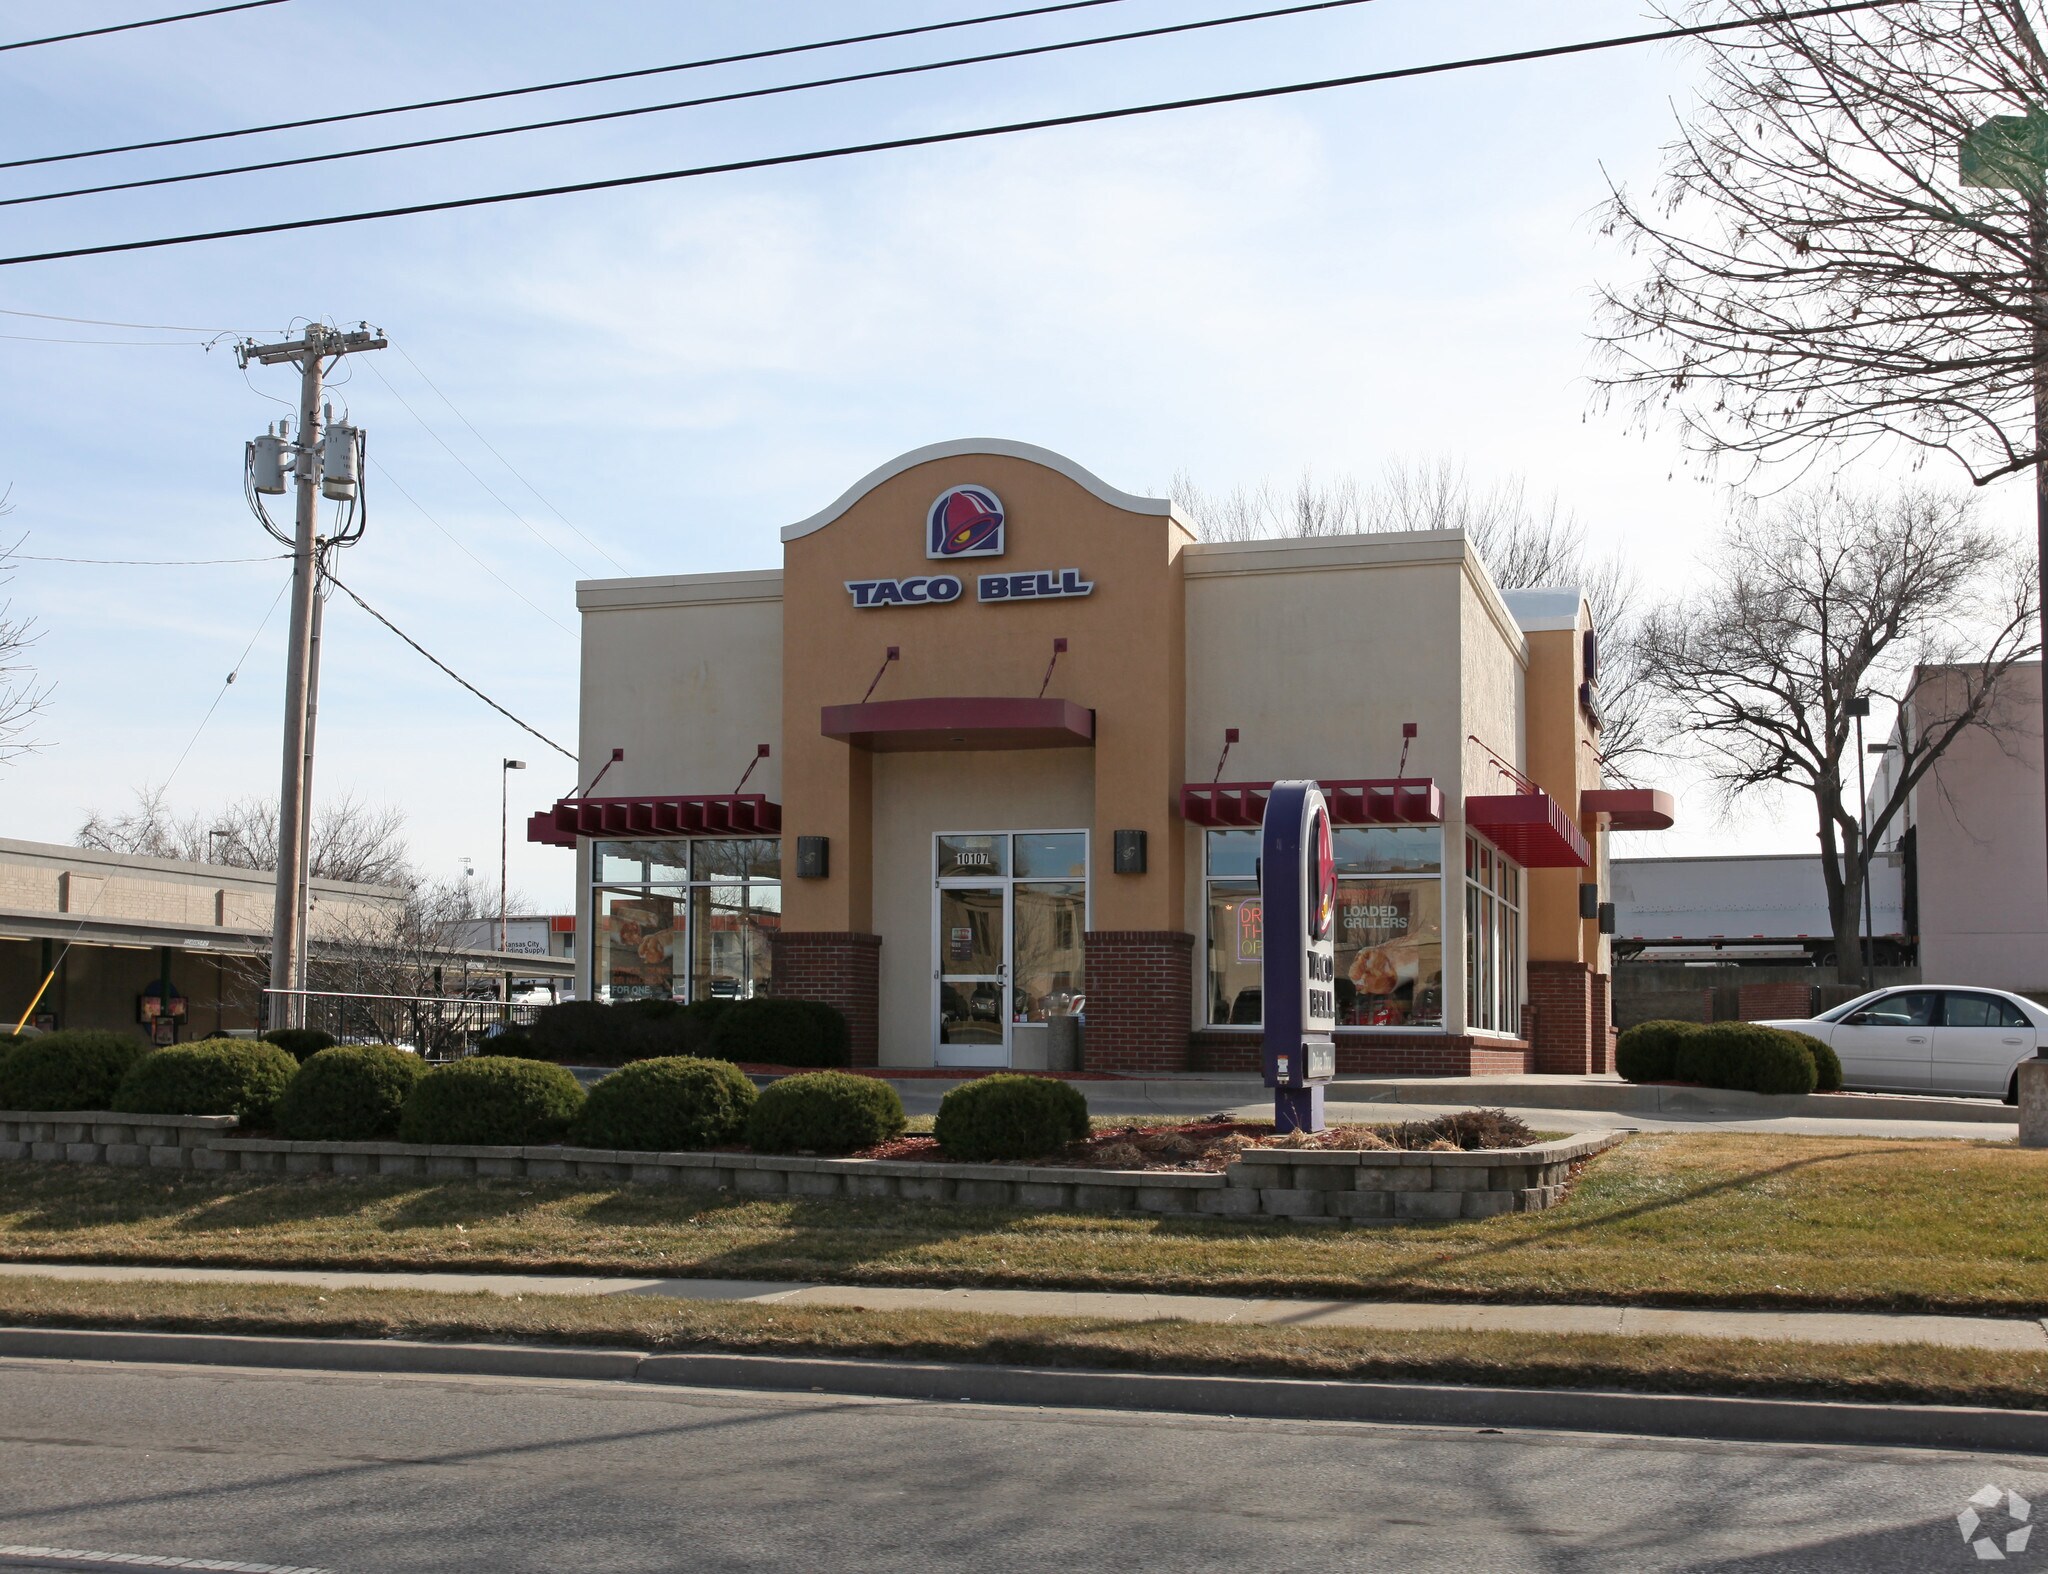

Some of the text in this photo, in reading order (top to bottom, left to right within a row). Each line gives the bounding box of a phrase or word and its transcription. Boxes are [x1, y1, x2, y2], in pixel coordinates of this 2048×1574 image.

[848, 571, 1090, 605] TACO BELL
[958, 853, 988, 864] 10107
[1240, 907, 1263, 923] DR
[1343, 905, 1398, 917] LOADED
[1343, 917, 1408, 929] GRILLERS
[1242, 924, 1263, 939] TH
[524, 946, 546, 955] Supply
[527, 941, 540, 949] City
[1241, 939, 1263, 955] OP
[1307, 950, 1334, 984] TACO
[611, 985, 630, 994] FOR
[1309, 988, 1335, 1019] BELL
[1312, 1051, 1323, 1071] Drive
